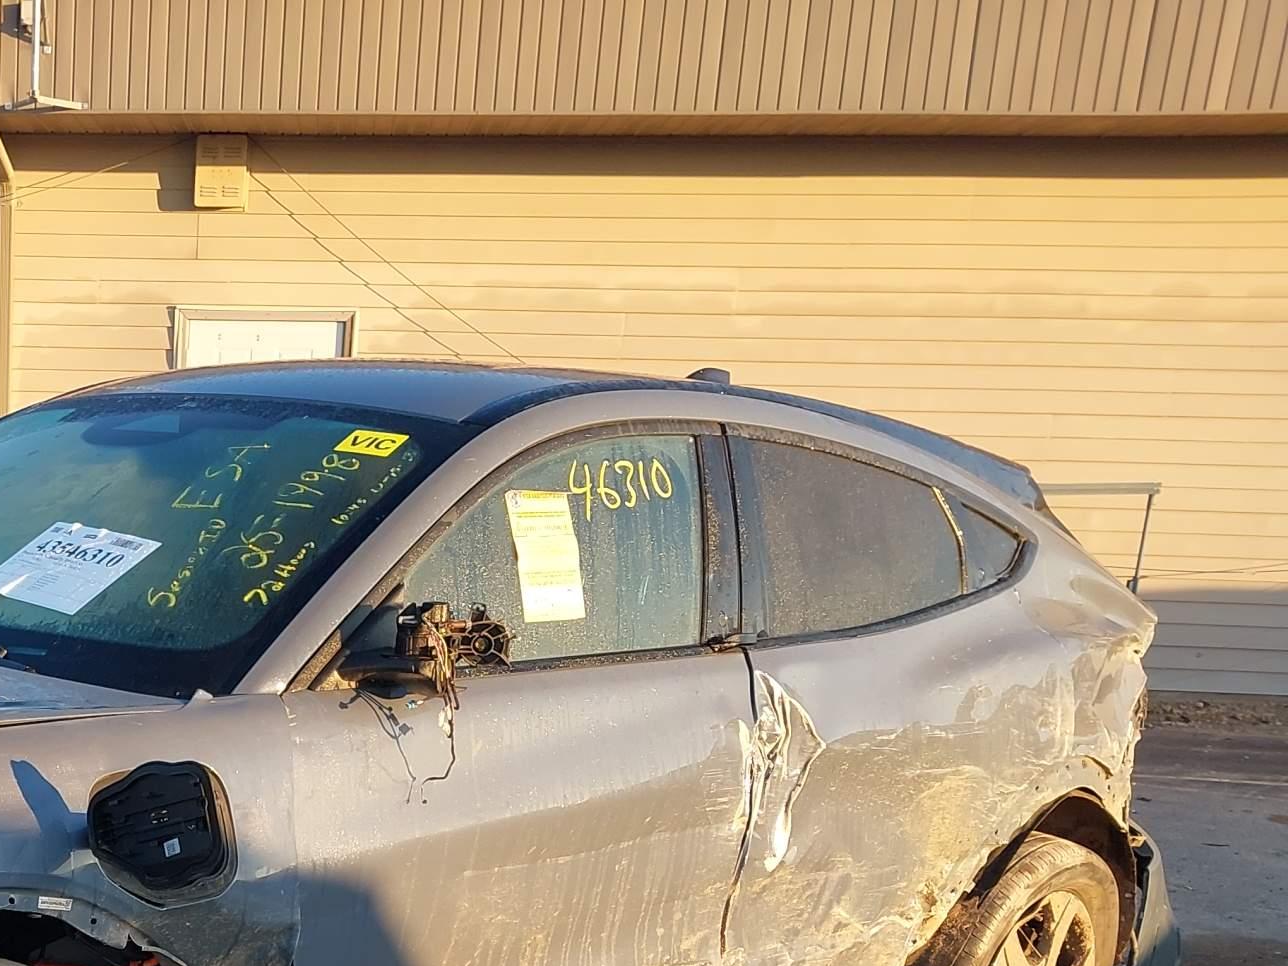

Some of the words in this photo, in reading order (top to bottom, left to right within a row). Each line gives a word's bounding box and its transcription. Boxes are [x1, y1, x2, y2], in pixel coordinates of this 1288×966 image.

[351, 435, 397, 450] VIC
[568, 458, 672, 522] 46310
[36, 538, 126, 568] 43546310
